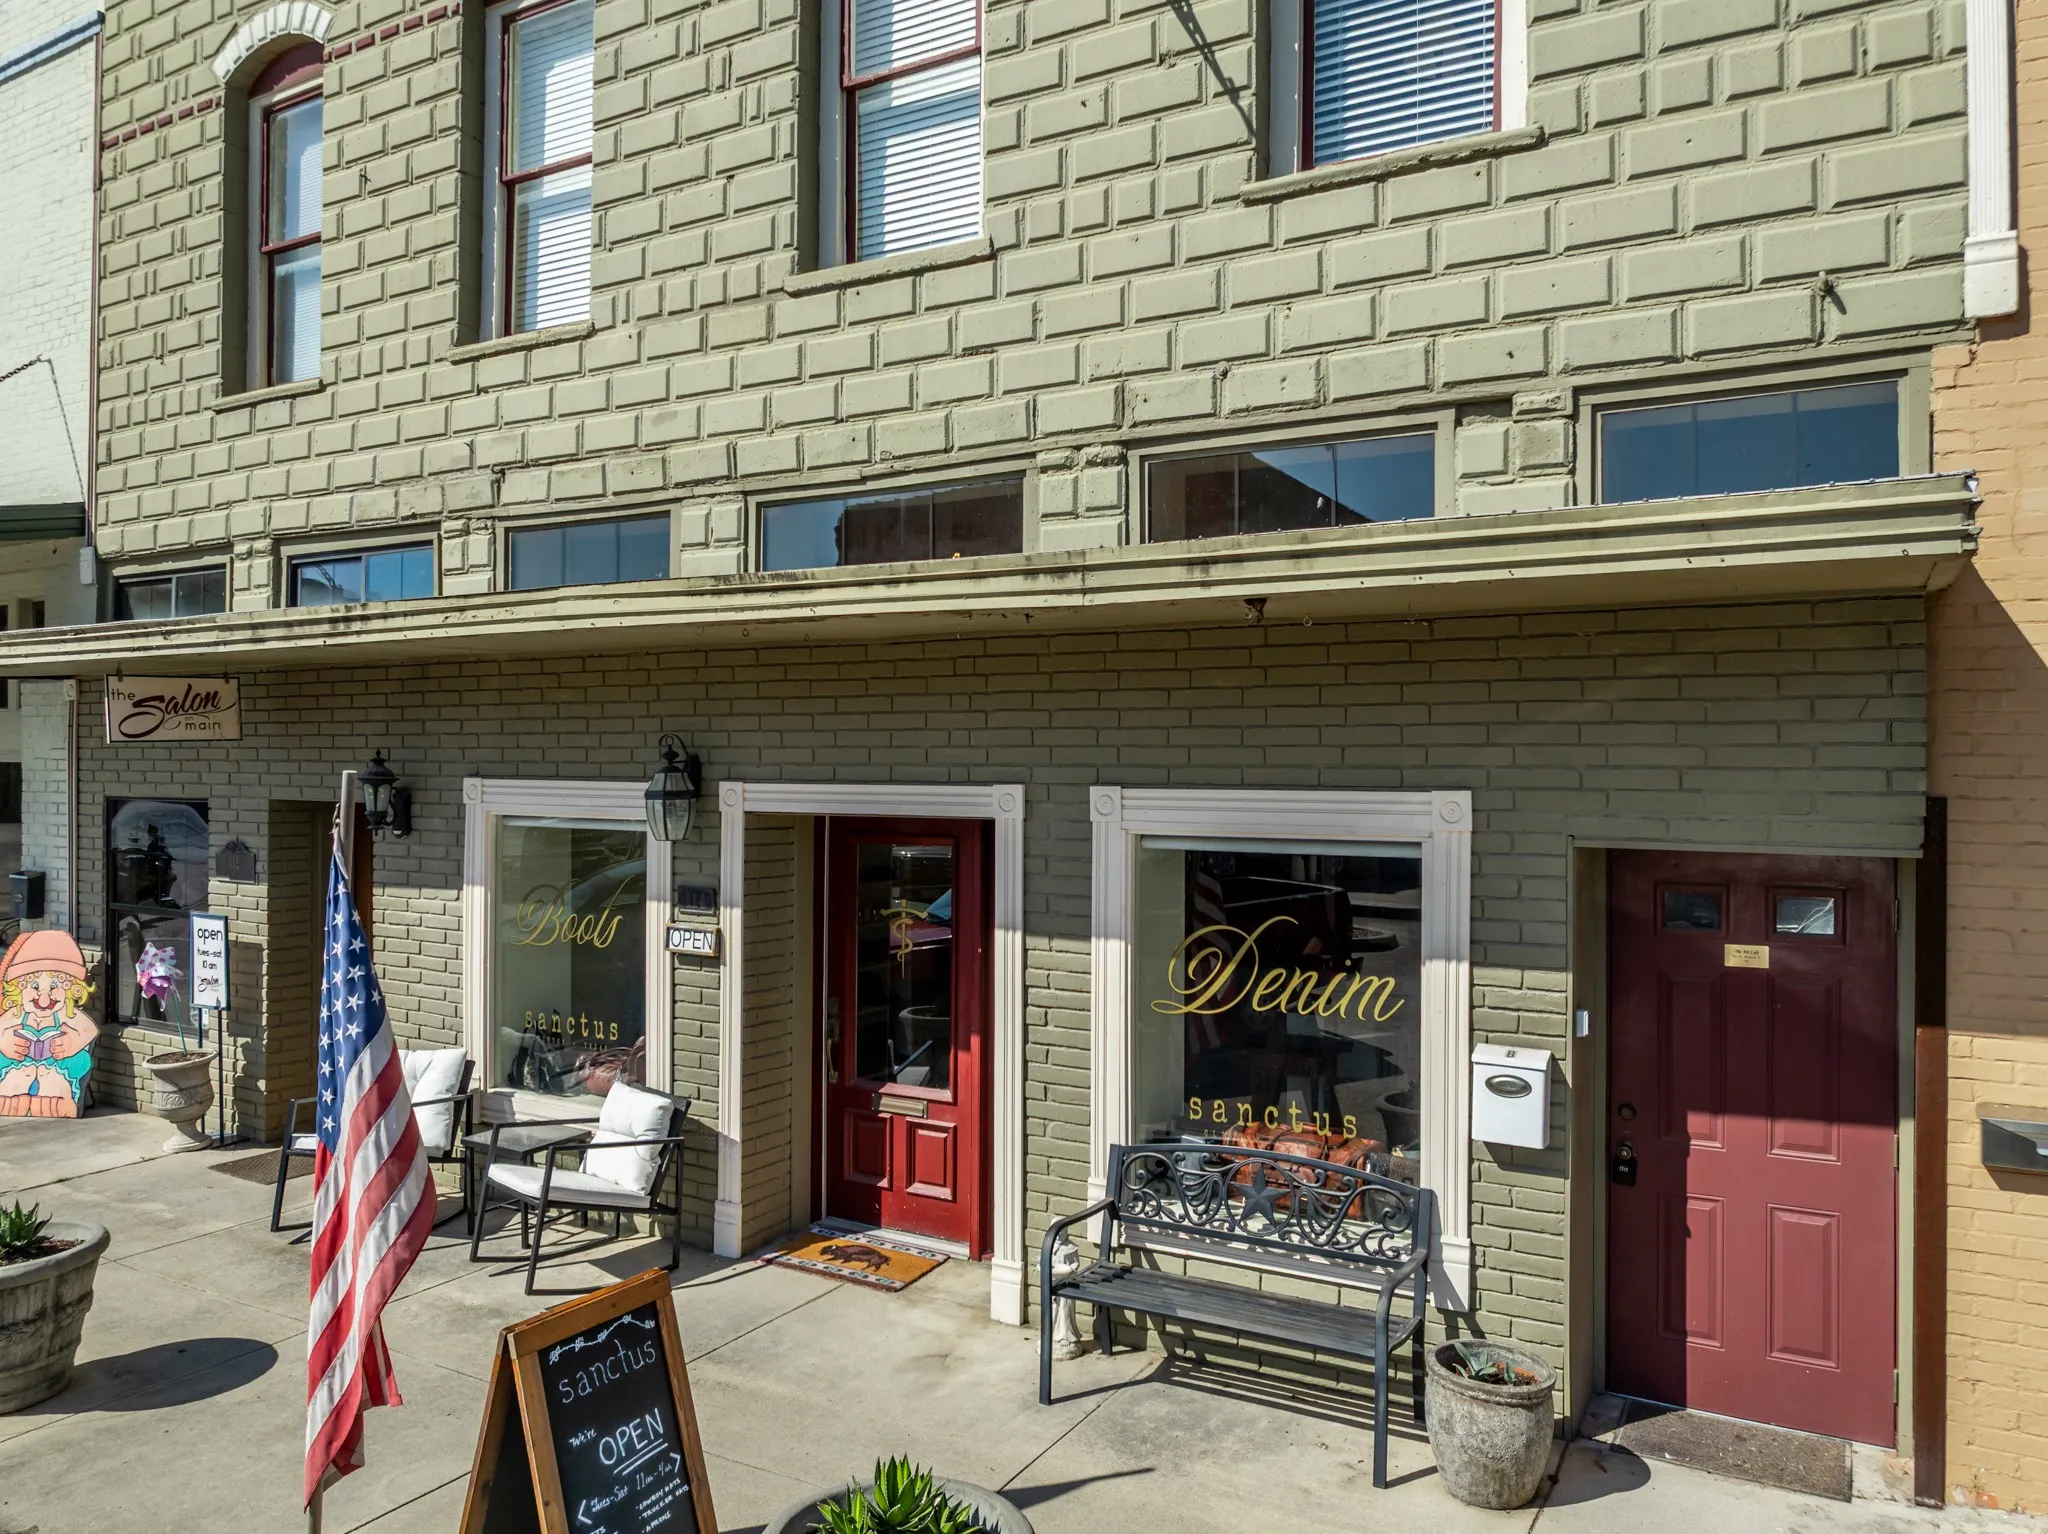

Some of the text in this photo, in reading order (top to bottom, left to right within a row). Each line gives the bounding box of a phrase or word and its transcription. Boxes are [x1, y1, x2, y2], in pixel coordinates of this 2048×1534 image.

[111, 683, 222, 739] the Salon
[185, 721, 221, 731] main
[509, 874, 636, 949] Boots
[197, 927, 223, 945] open
[670, 928, 713, 951] OPEN
[202, 960, 208, 969] 10
[1150, 915, 1405, 1022] Denim
[524, 1009, 619, 1041] sanctus
[1506, 1050, 1516, 1059] B
[1188, 1096, 1358, 1139] sanctus
[558, 1339, 657, 1404] sanctus
[568, 1407, 664, 1465] We're OPEN
[641, 1483, 690, 1519] TRUCKER HATS
[664, 1477, 681, 1493] HATS
[645, 1510, 672, 1533] APRONS
